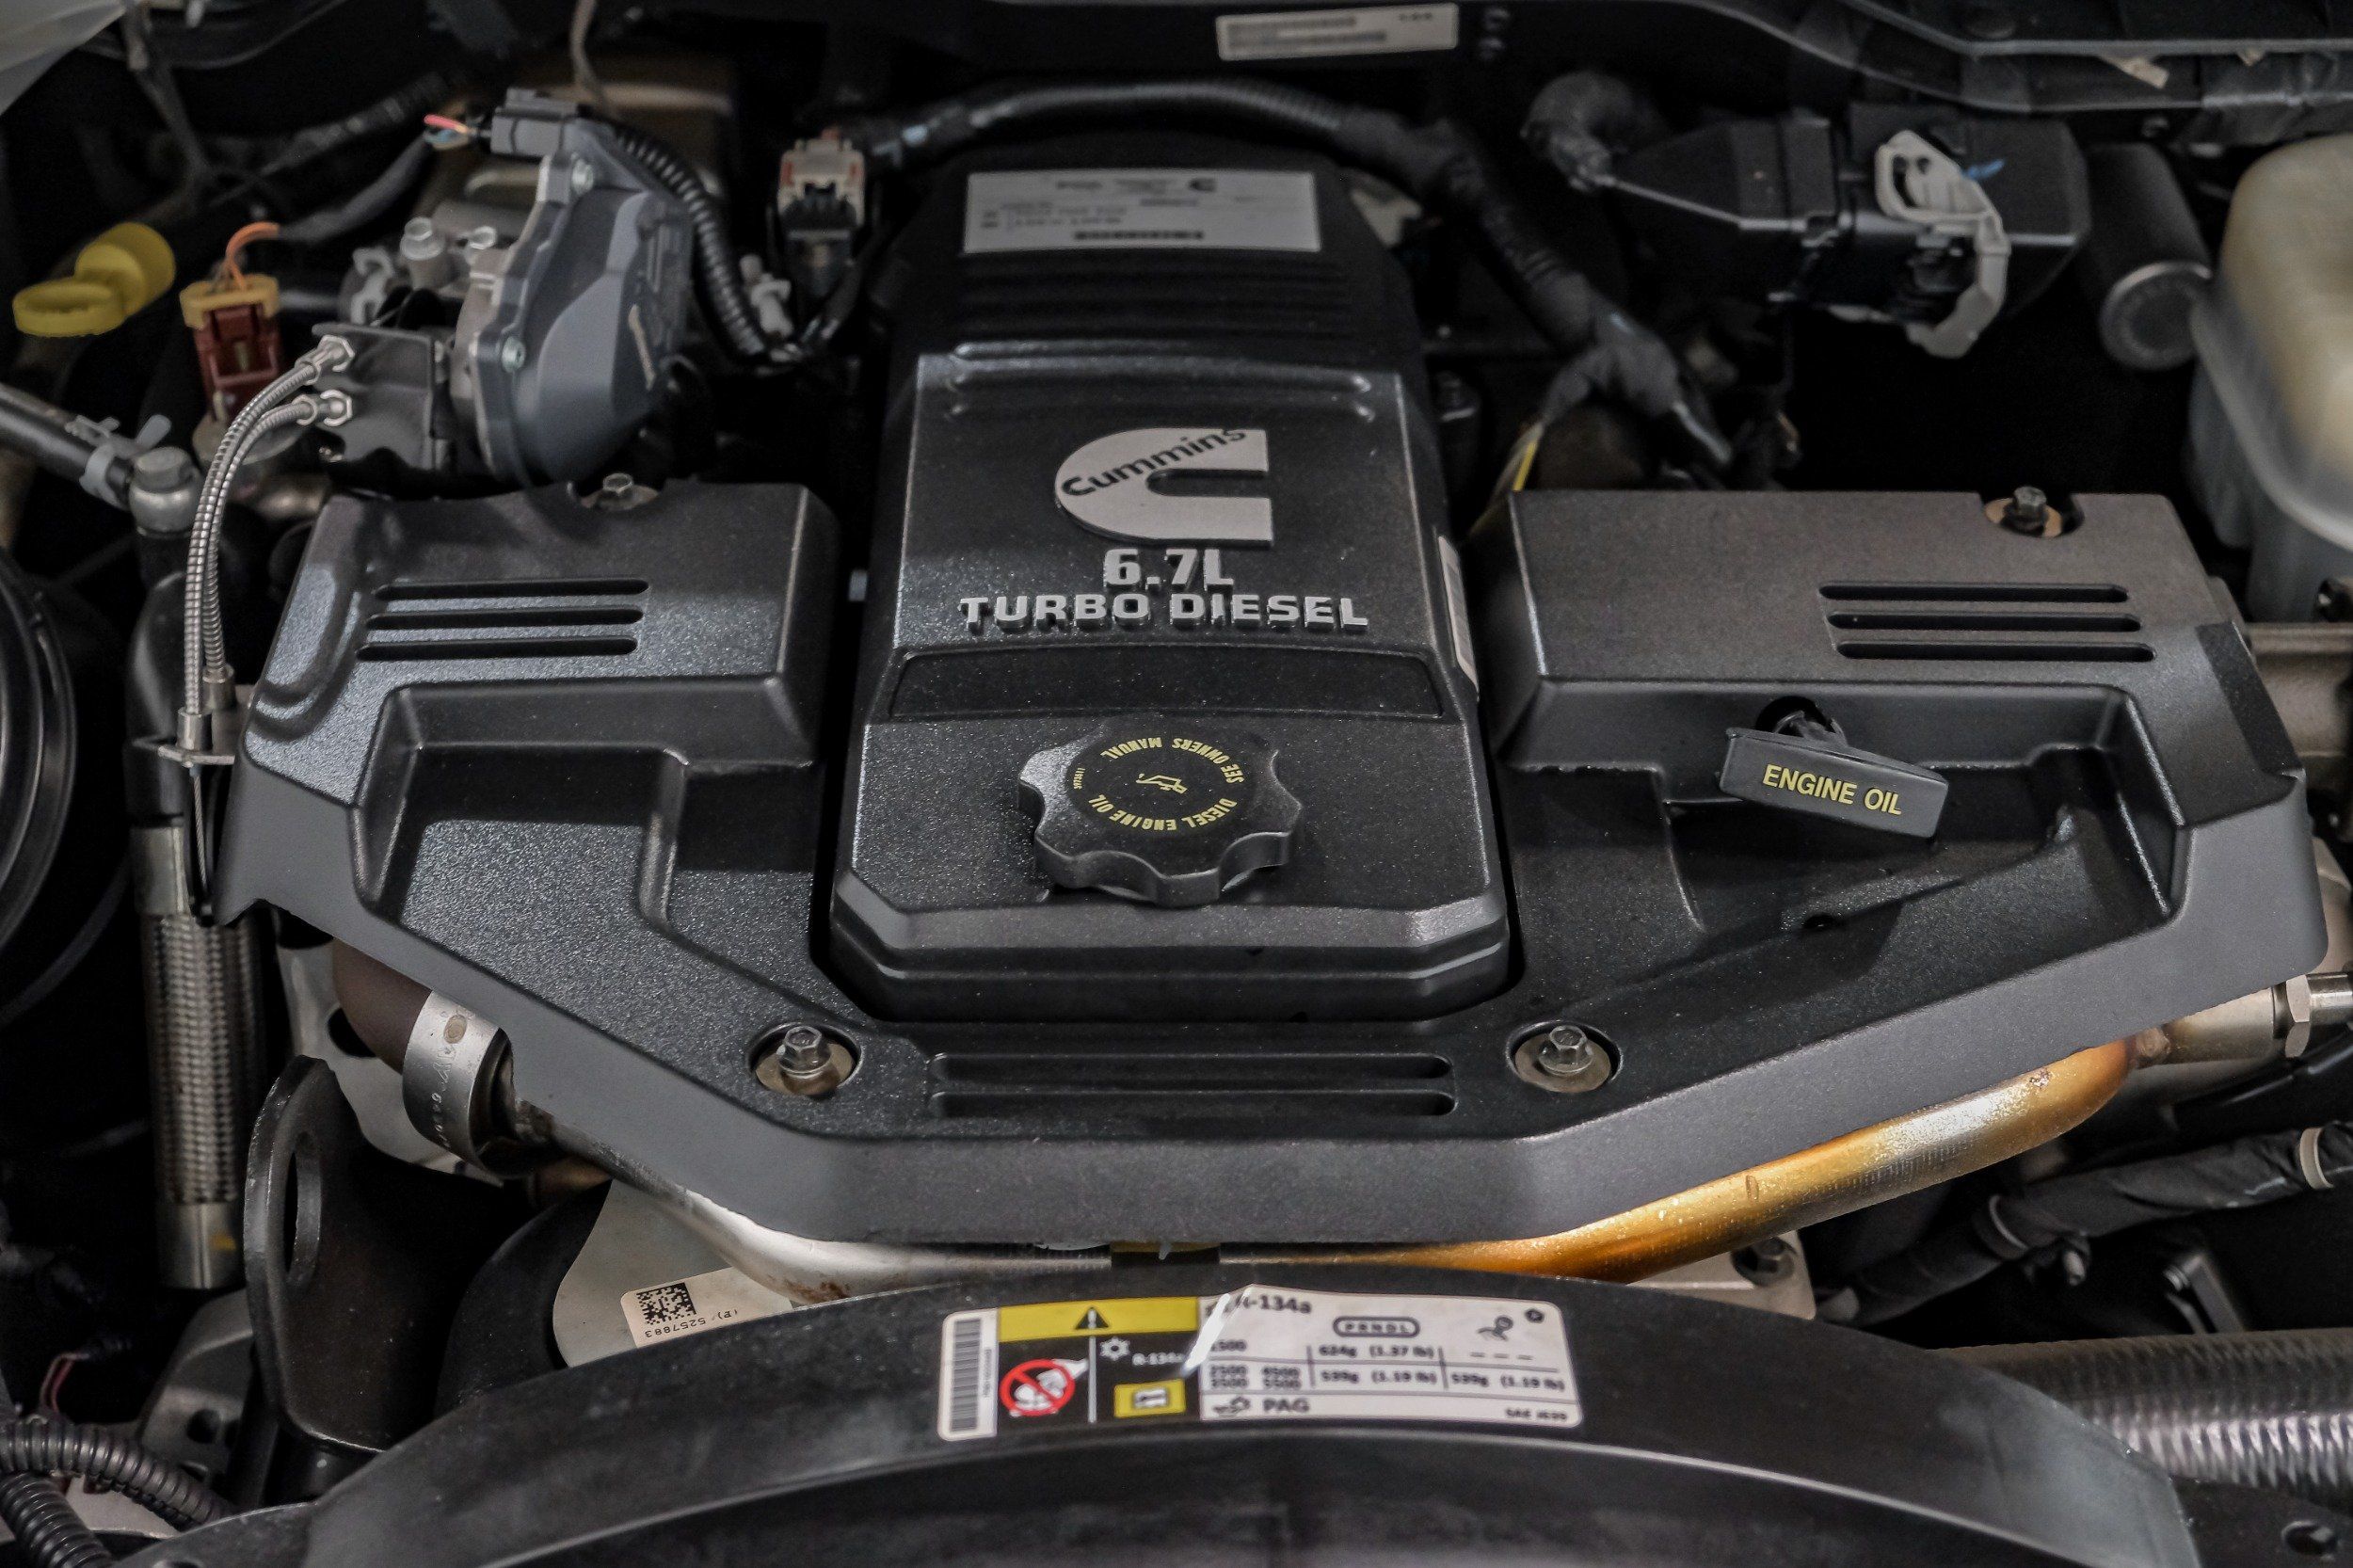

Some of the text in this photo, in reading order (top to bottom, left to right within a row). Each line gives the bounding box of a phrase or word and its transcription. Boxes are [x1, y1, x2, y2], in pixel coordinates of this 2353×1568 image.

[1061, 427, 1247, 496] Cummins
[1103, 549, 1234, 591] 6.7L
[959, 593, 1369, 633] TURBO DIESEL
[1099, 737, 1245, 785] SEE OWNERS MANUAL
[1762, 763, 1903, 816] ENGINE OIL
[1088, 793, 1238, 831] DIESEL ENGINE OIL
[645, 1317, 707, 1338] 5257883
[1262, 1399, 1311, 1413] PAG
